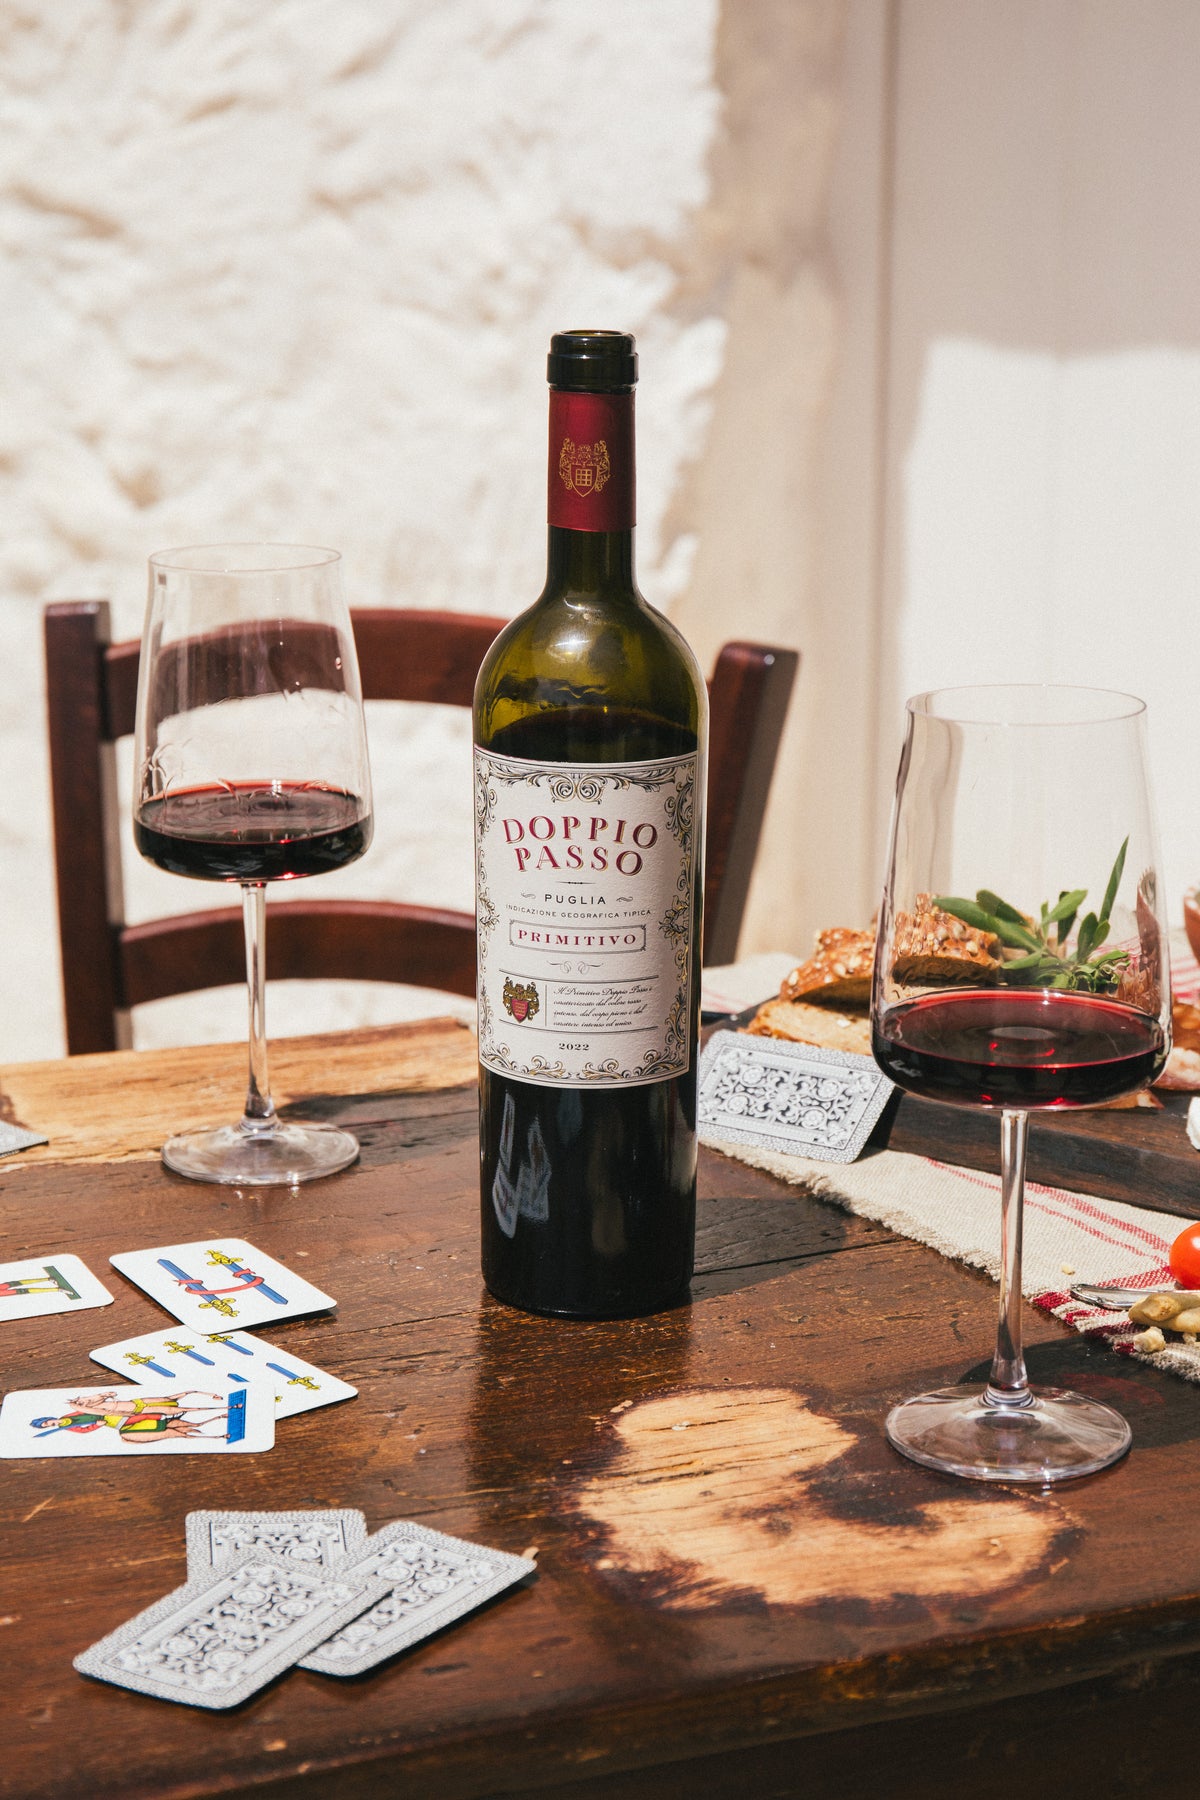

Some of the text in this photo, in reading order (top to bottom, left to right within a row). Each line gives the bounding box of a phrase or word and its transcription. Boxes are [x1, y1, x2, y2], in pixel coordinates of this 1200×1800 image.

[502, 815, 658, 849] DOPPIO
[514, 845, 643, 876] PASSO
[544, 894, 606, 904] PUGLIA
[505, 904, 556, 917] INDICAZIONE
[623, 909, 651, 917] TIPICA
[518, 929, 636, 946] PRIMITIVO
[565, 986, 600, 996] Primitivo
[558, 1043, 590, 1051] 2022
